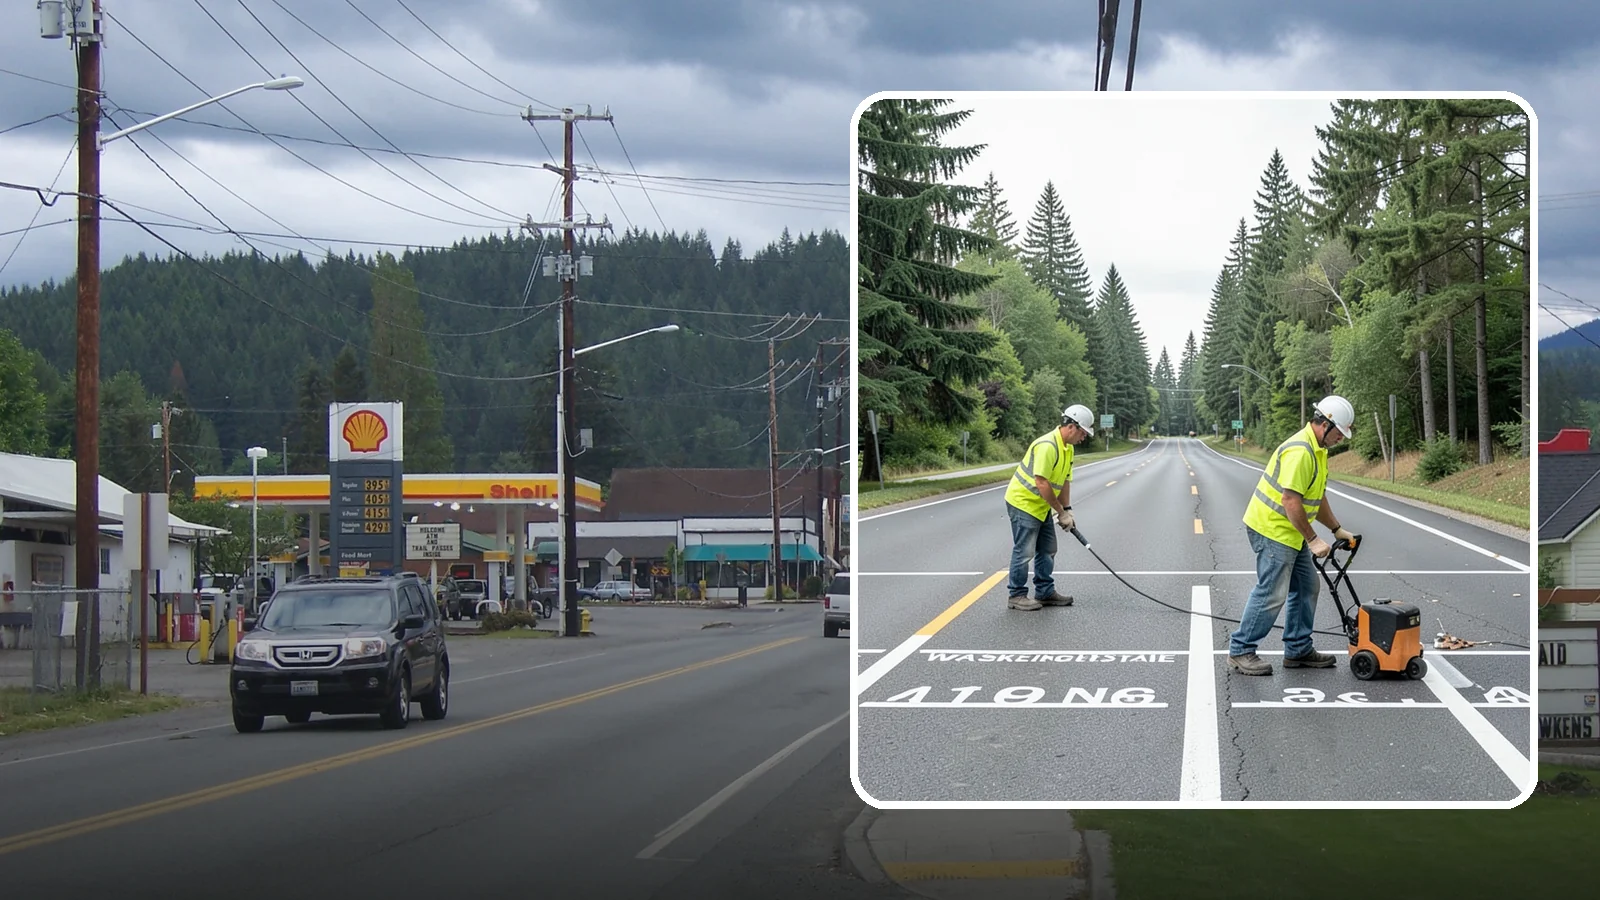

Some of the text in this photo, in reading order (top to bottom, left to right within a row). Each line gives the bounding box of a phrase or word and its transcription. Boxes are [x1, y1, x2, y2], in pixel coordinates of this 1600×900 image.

[366, 480, 384, 490] 395
[490, 484, 547, 499] Shell
[366, 494, 384, 504] 405
[366, 508, 384, 518] 415
[366, 522, 384, 533] 429
[1539, 642, 1567, 666] AID
[1538, 716, 1592, 739] WKENS
